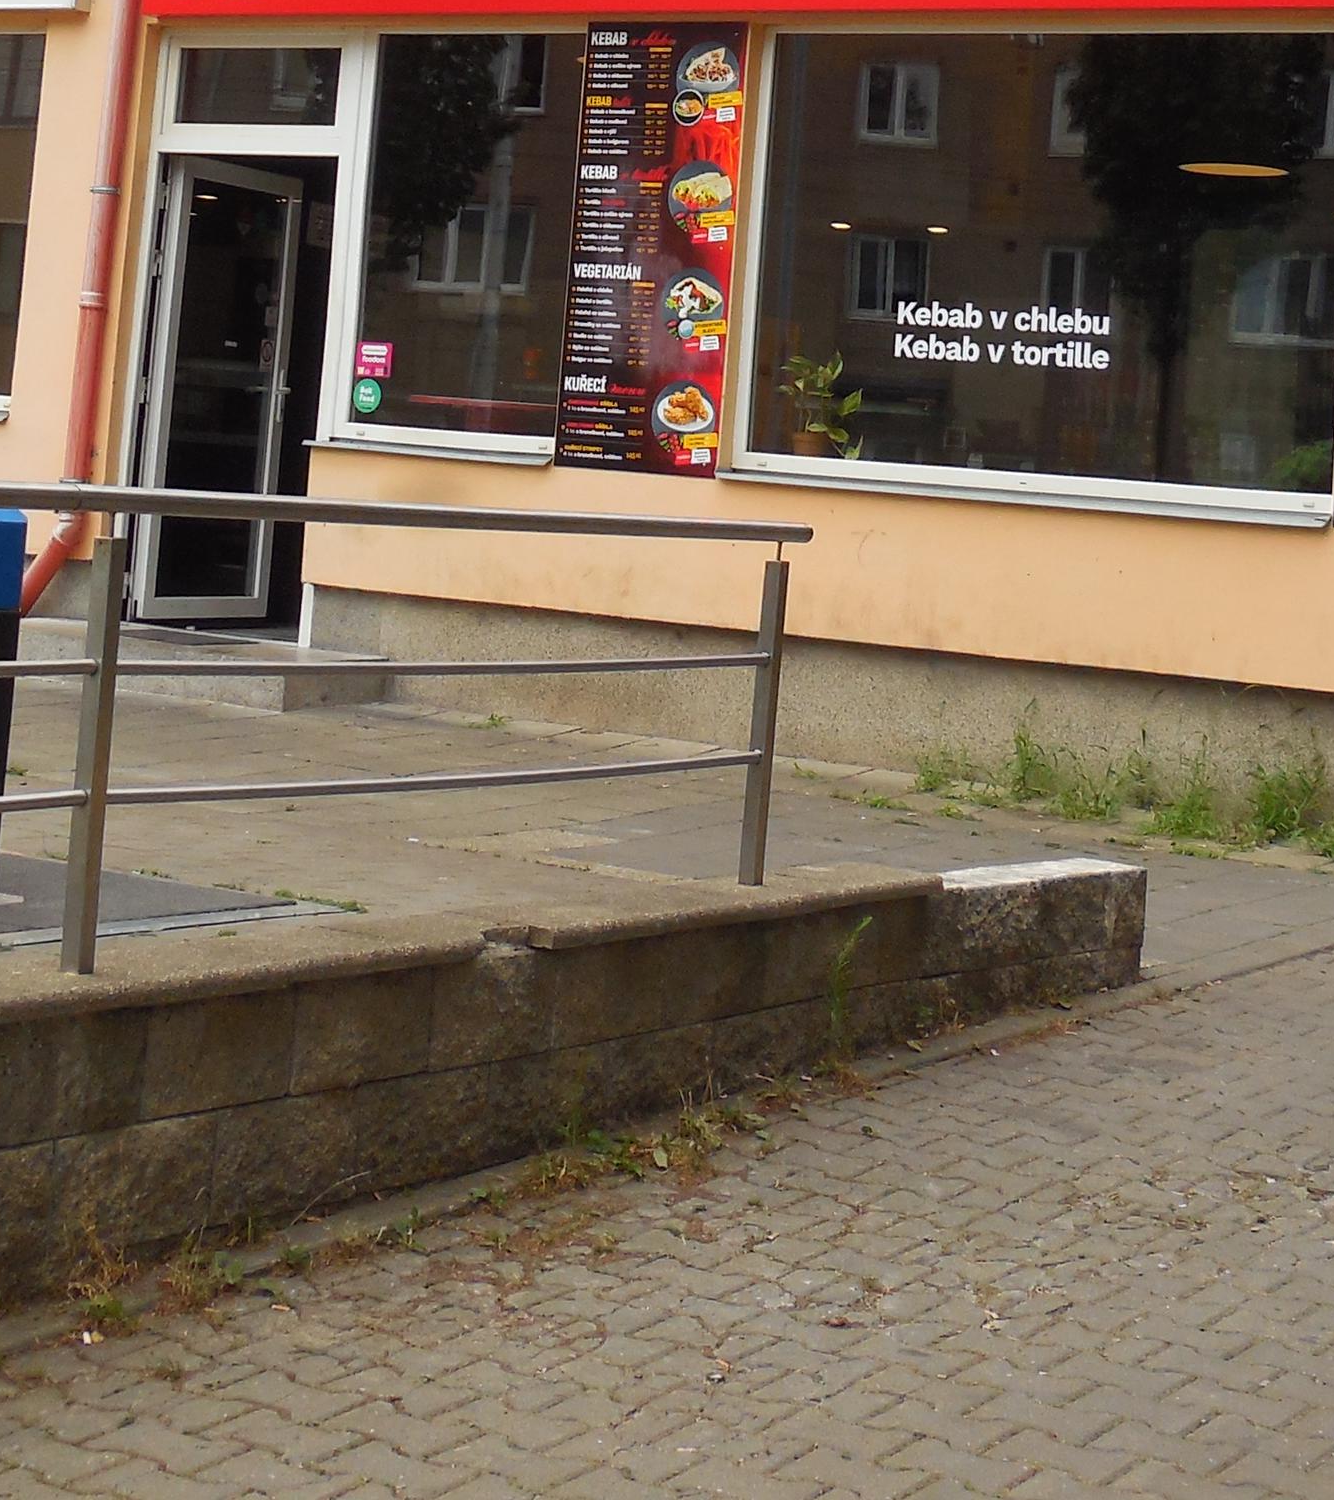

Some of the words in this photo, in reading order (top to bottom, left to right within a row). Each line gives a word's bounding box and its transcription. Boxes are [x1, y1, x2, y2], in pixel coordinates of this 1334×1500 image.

[591, 32, 628, 46] KEBAB
[586, 96, 612, 107] KEBAB
[580, 165, 618, 180] KEBAB
[574, 262, 642, 280] VEGETARIÁN
[897, 301, 983, 329] Kebab
[990, 311, 1008, 330] v
[1014, 306, 1110, 335] chlebu
[894, 334, 980, 362] Kebab
[987, 344, 1006, 363] v
[1011, 340, 1110, 369] tortille
[564, 374, 607, 393] KUŘECÍ
